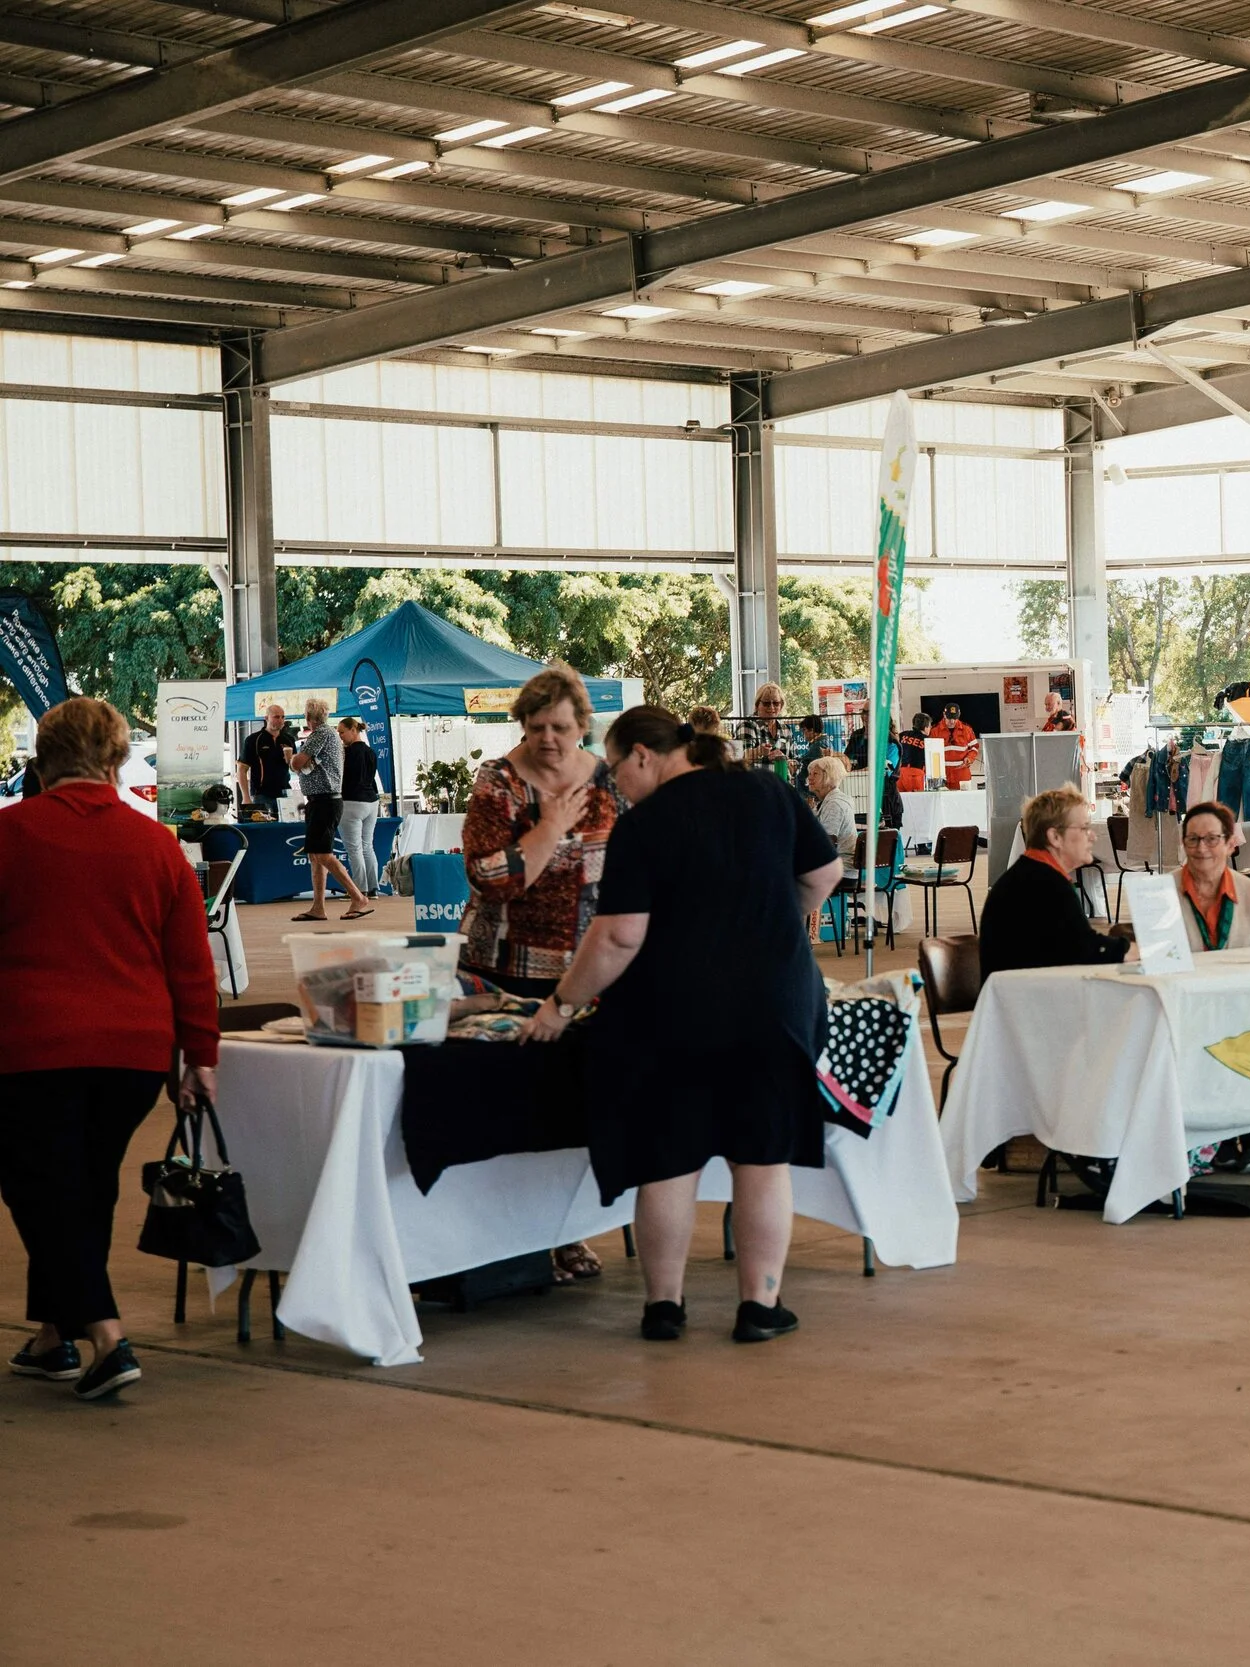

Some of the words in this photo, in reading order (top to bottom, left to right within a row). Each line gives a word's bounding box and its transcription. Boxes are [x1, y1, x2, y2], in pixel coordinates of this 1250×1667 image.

[12, 608, 31, 639] People
[28, 637, 40, 654] like
[36, 652, 50, 671] you
[3, 617, 17, 636] who
[14, 635, 29, 655] care
[26, 654, 49, 688] enough
[2, 634, 20, 658] make
[17, 658, 24, 666] a
[22, 664, 50, 710] difference.
[366, 722, 384, 732] Saving
[372, 735, 386, 745] Lives
[184, 750, 200, 760] 24/7
[378, 748, 389, 759] 24/7
[415, 904, 462, 920] RSPCA
